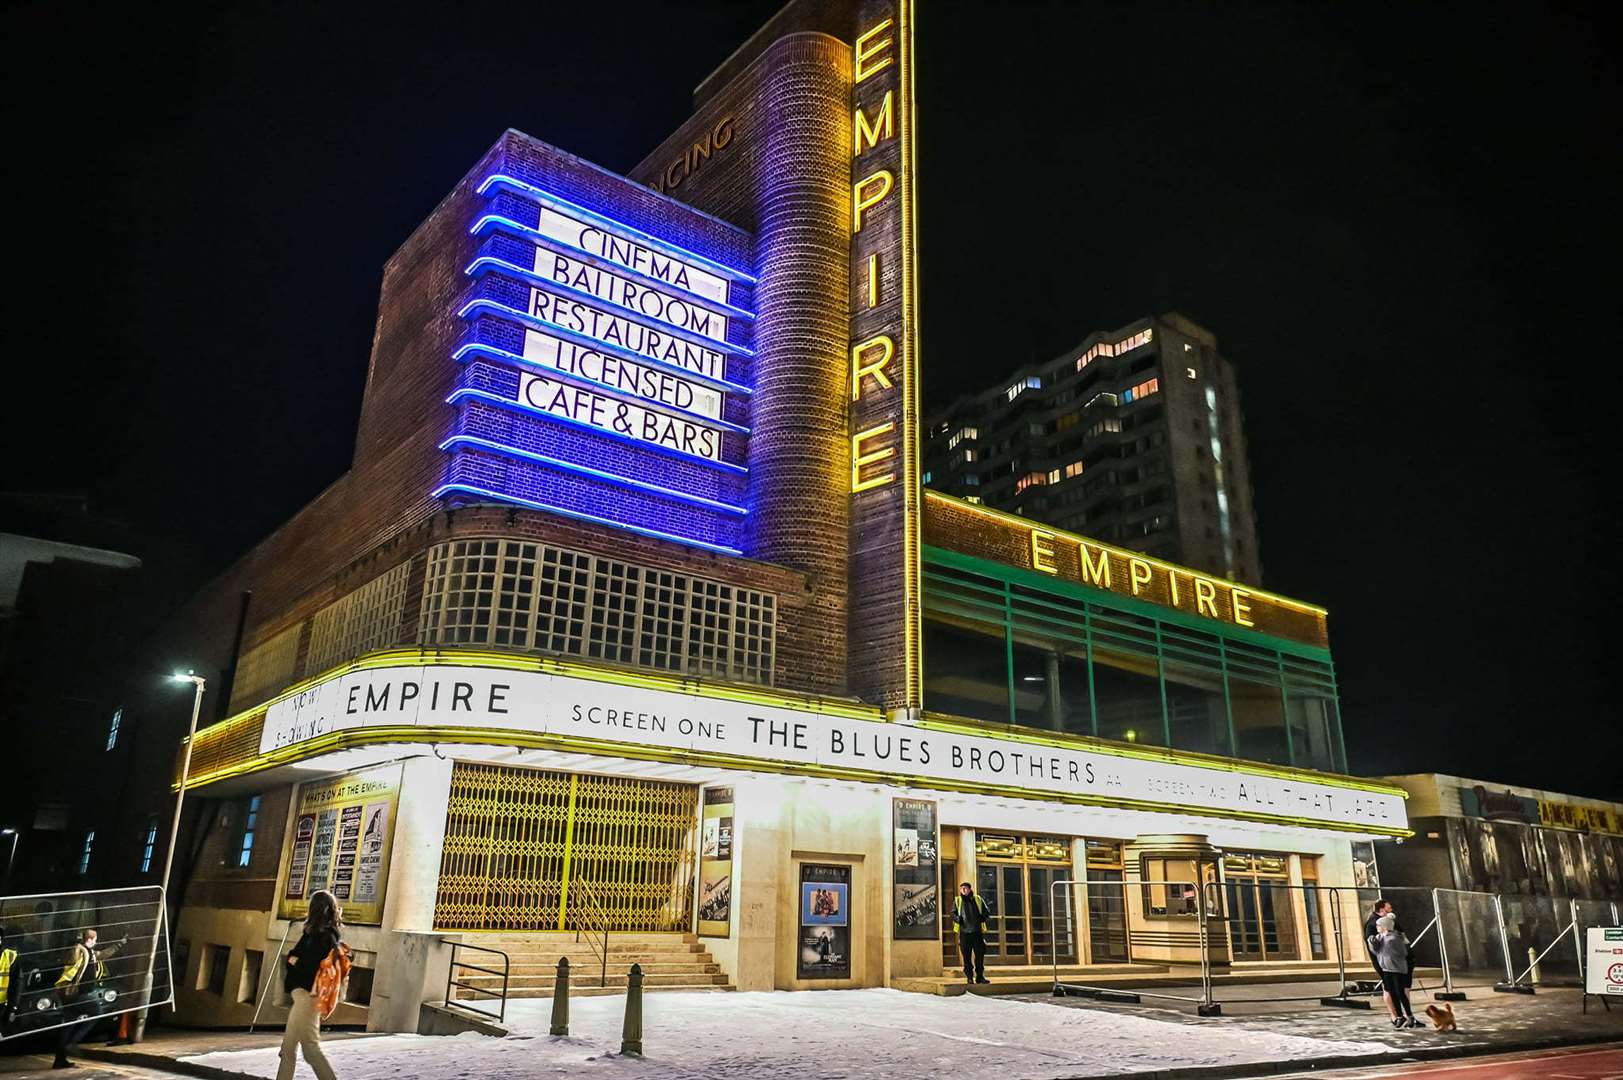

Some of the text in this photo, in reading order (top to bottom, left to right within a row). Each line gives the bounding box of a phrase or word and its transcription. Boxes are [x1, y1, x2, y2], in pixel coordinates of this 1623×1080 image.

[579, 227, 691, 290] CINEMA
[853, 17, 895, 494] EMPIRE
[533, 291, 720, 376] RESTAURANT
[553, 257, 711, 336] BALLROOM
[555, 340, 694, 409] LICENSED
[525, 377, 714, 458] CAFE & BARS
[1031, 529, 1255, 627] EMPIRE
[346, 681, 511, 715] EMPIRE
[572, 704, 666, 732] SCREEN
[678, 718, 726, 740] ONE
[747, 716, 808, 750] THE
[831, 729, 931, 764] BLUES
[952, 744, 1096, 785] BROTHERS
[347, 784, 359, 796] THE
